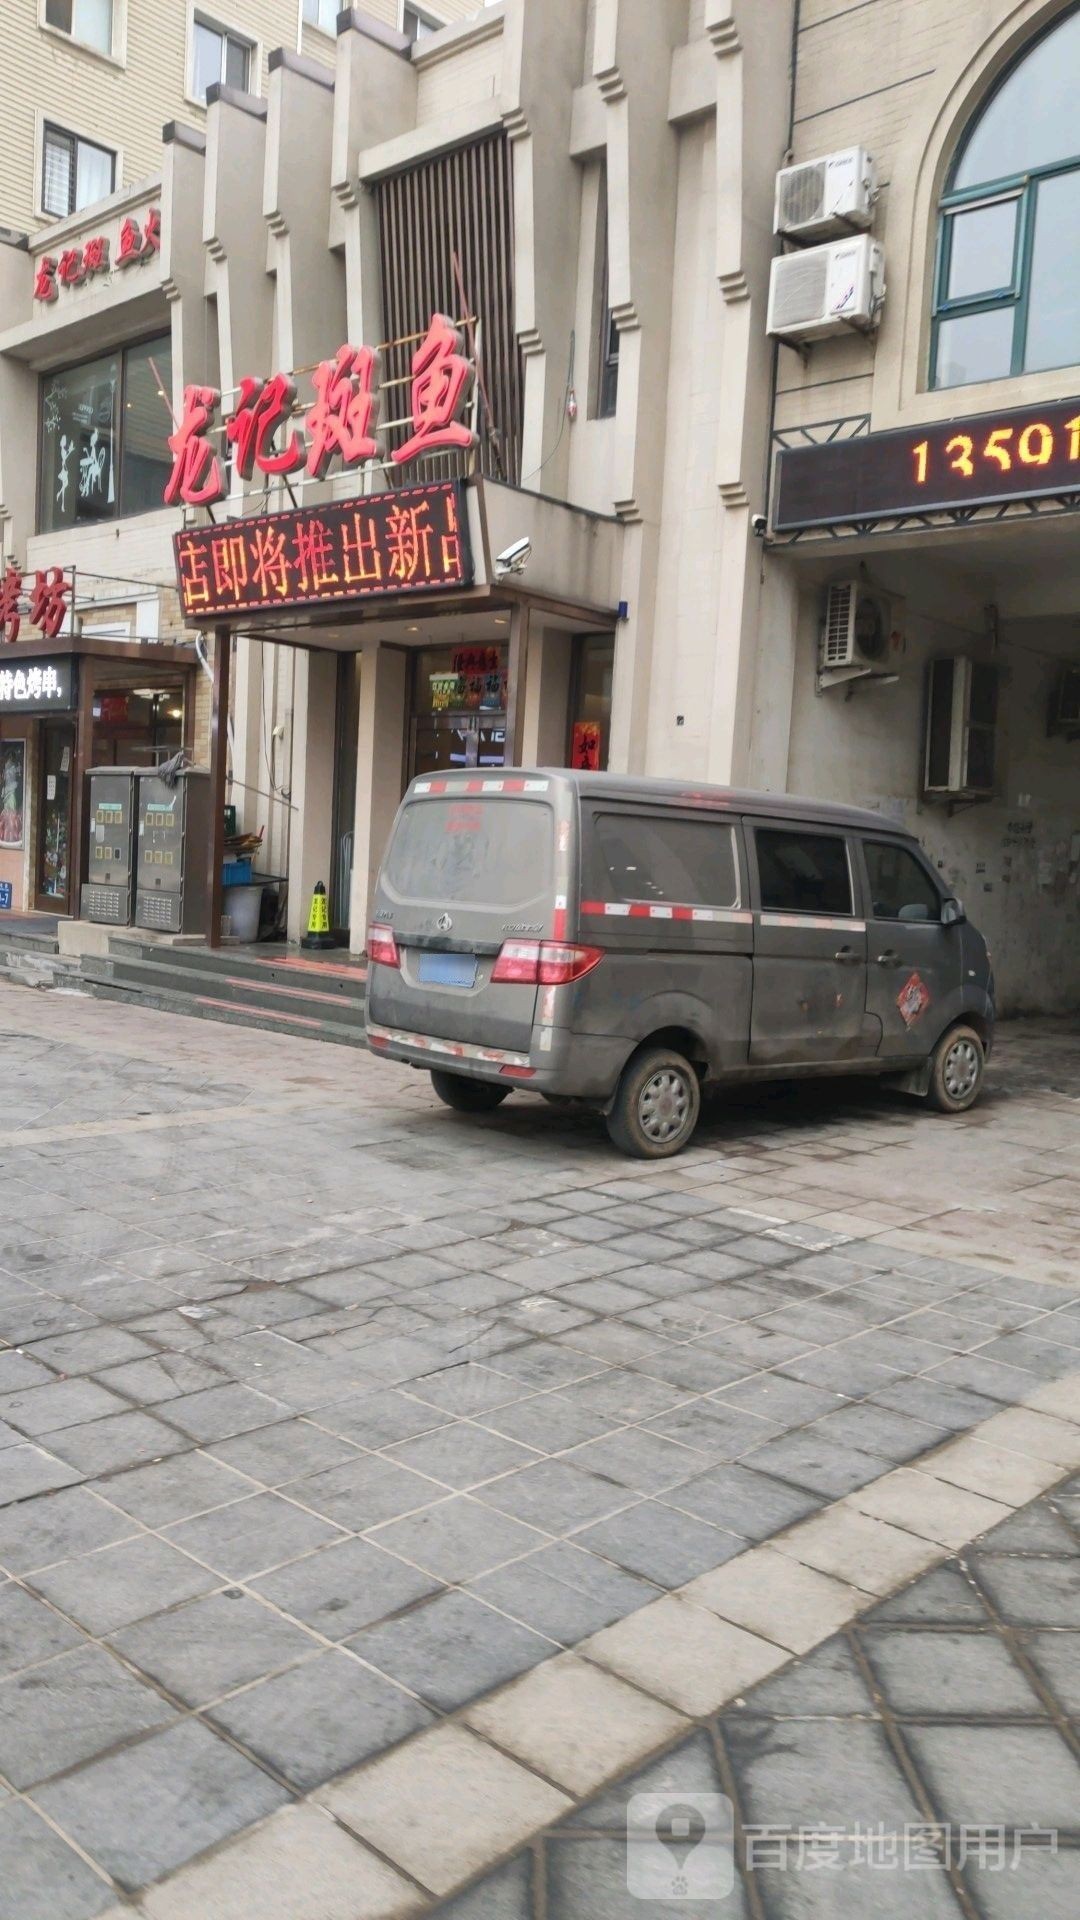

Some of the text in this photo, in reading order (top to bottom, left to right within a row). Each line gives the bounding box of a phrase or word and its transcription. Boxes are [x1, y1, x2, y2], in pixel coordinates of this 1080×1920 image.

[163, 312, 477, 506] 龙记斑鱼
[912, 416, 1080, 484] 13501
